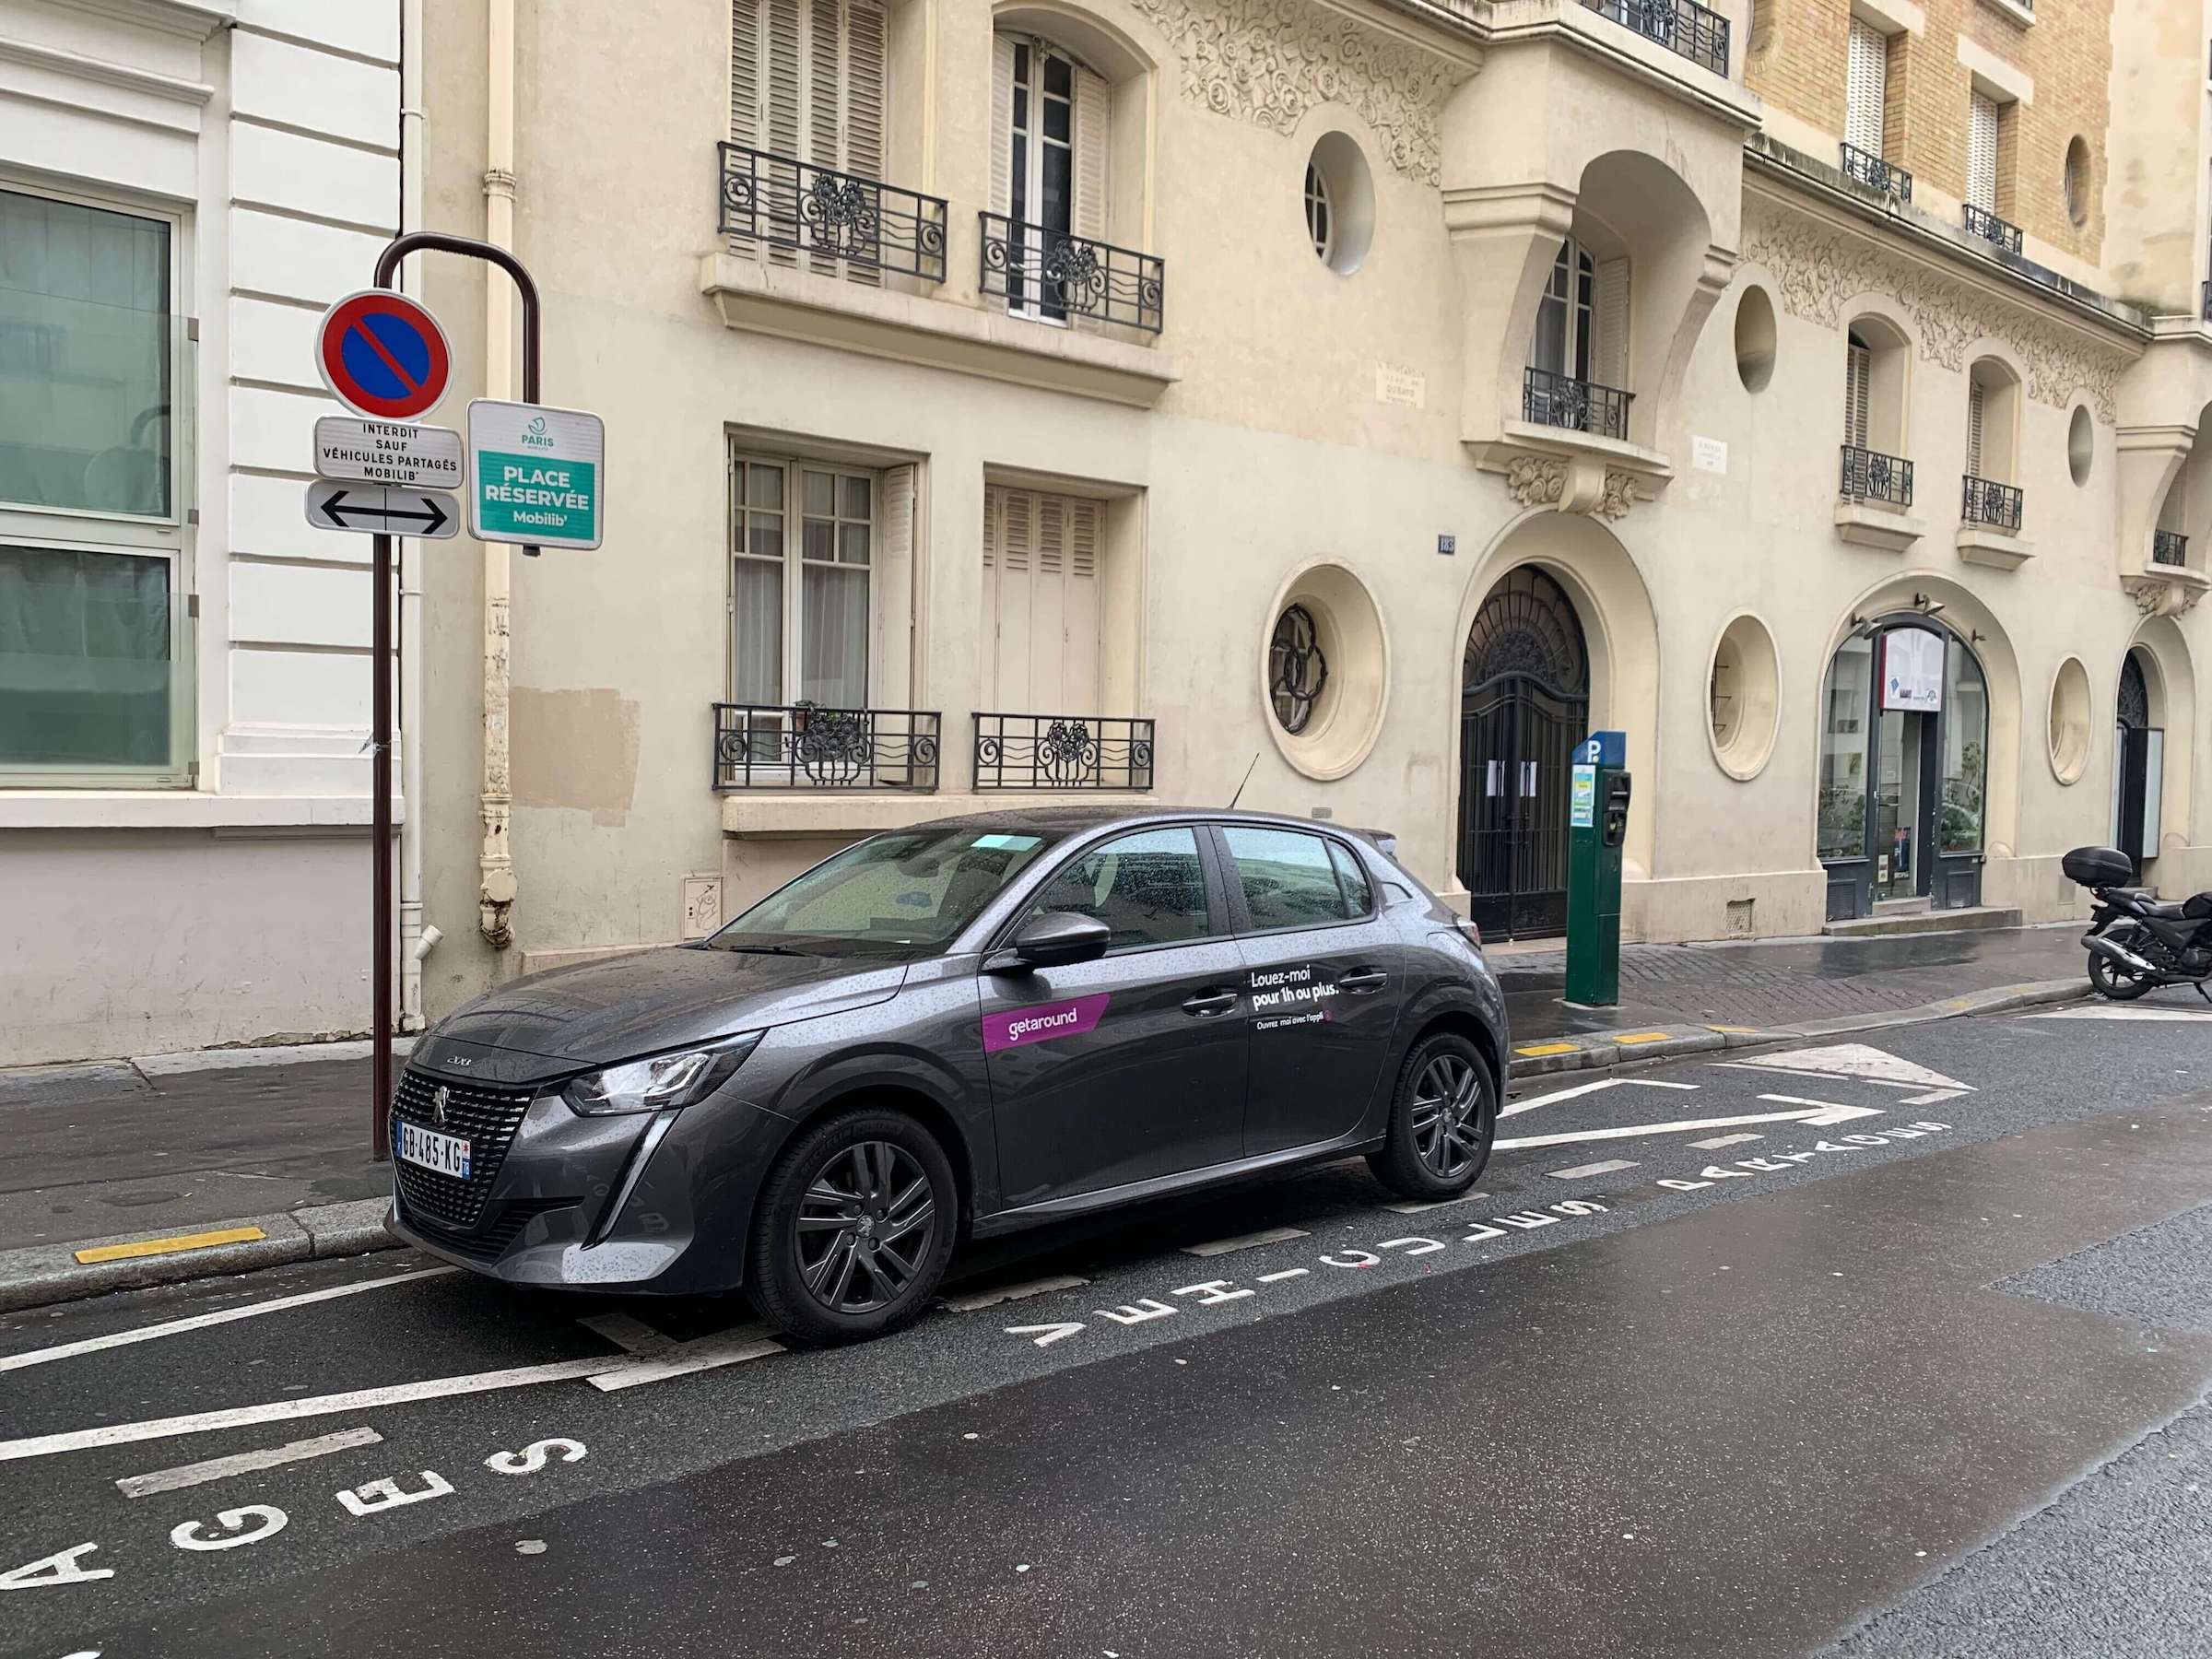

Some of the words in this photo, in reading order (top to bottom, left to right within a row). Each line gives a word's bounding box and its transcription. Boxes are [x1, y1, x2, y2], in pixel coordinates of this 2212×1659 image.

[363, 423, 418, 439] INTERDIT
[522, 434, 554, 447] PARIS
[376, 440, 407, 452] SAUF
[324, 447, 394, 465] VÉHICULES
[398, 456, 457, 472] PARTAGÉS
[503, 465, 571, 488] PLACE
[485, 483, 590, 511] RÉSERVÉE
[512, 511, 568, 527] Mobilib'
[1587, 740, 1602, 763] P
[1251, 964, 1311, 988] Louez-moi
[1253, 992, 1279, 1012] pour
[1280, 986, 1295, 1002] 1h
[1295, 987, 1311, 1000] ou
[1312, 982, 1340, 1003] plus.
[1008, 1007, 1077, 1041] getaround
[1256, 1020, 1278, 1030] Ouvrez
[1292, 1016, 1306, 1025] avec
[1656, 1121, 1952, 1191] PARTAGES
[1006, 1199, 1609, 1347] VEHICULES
